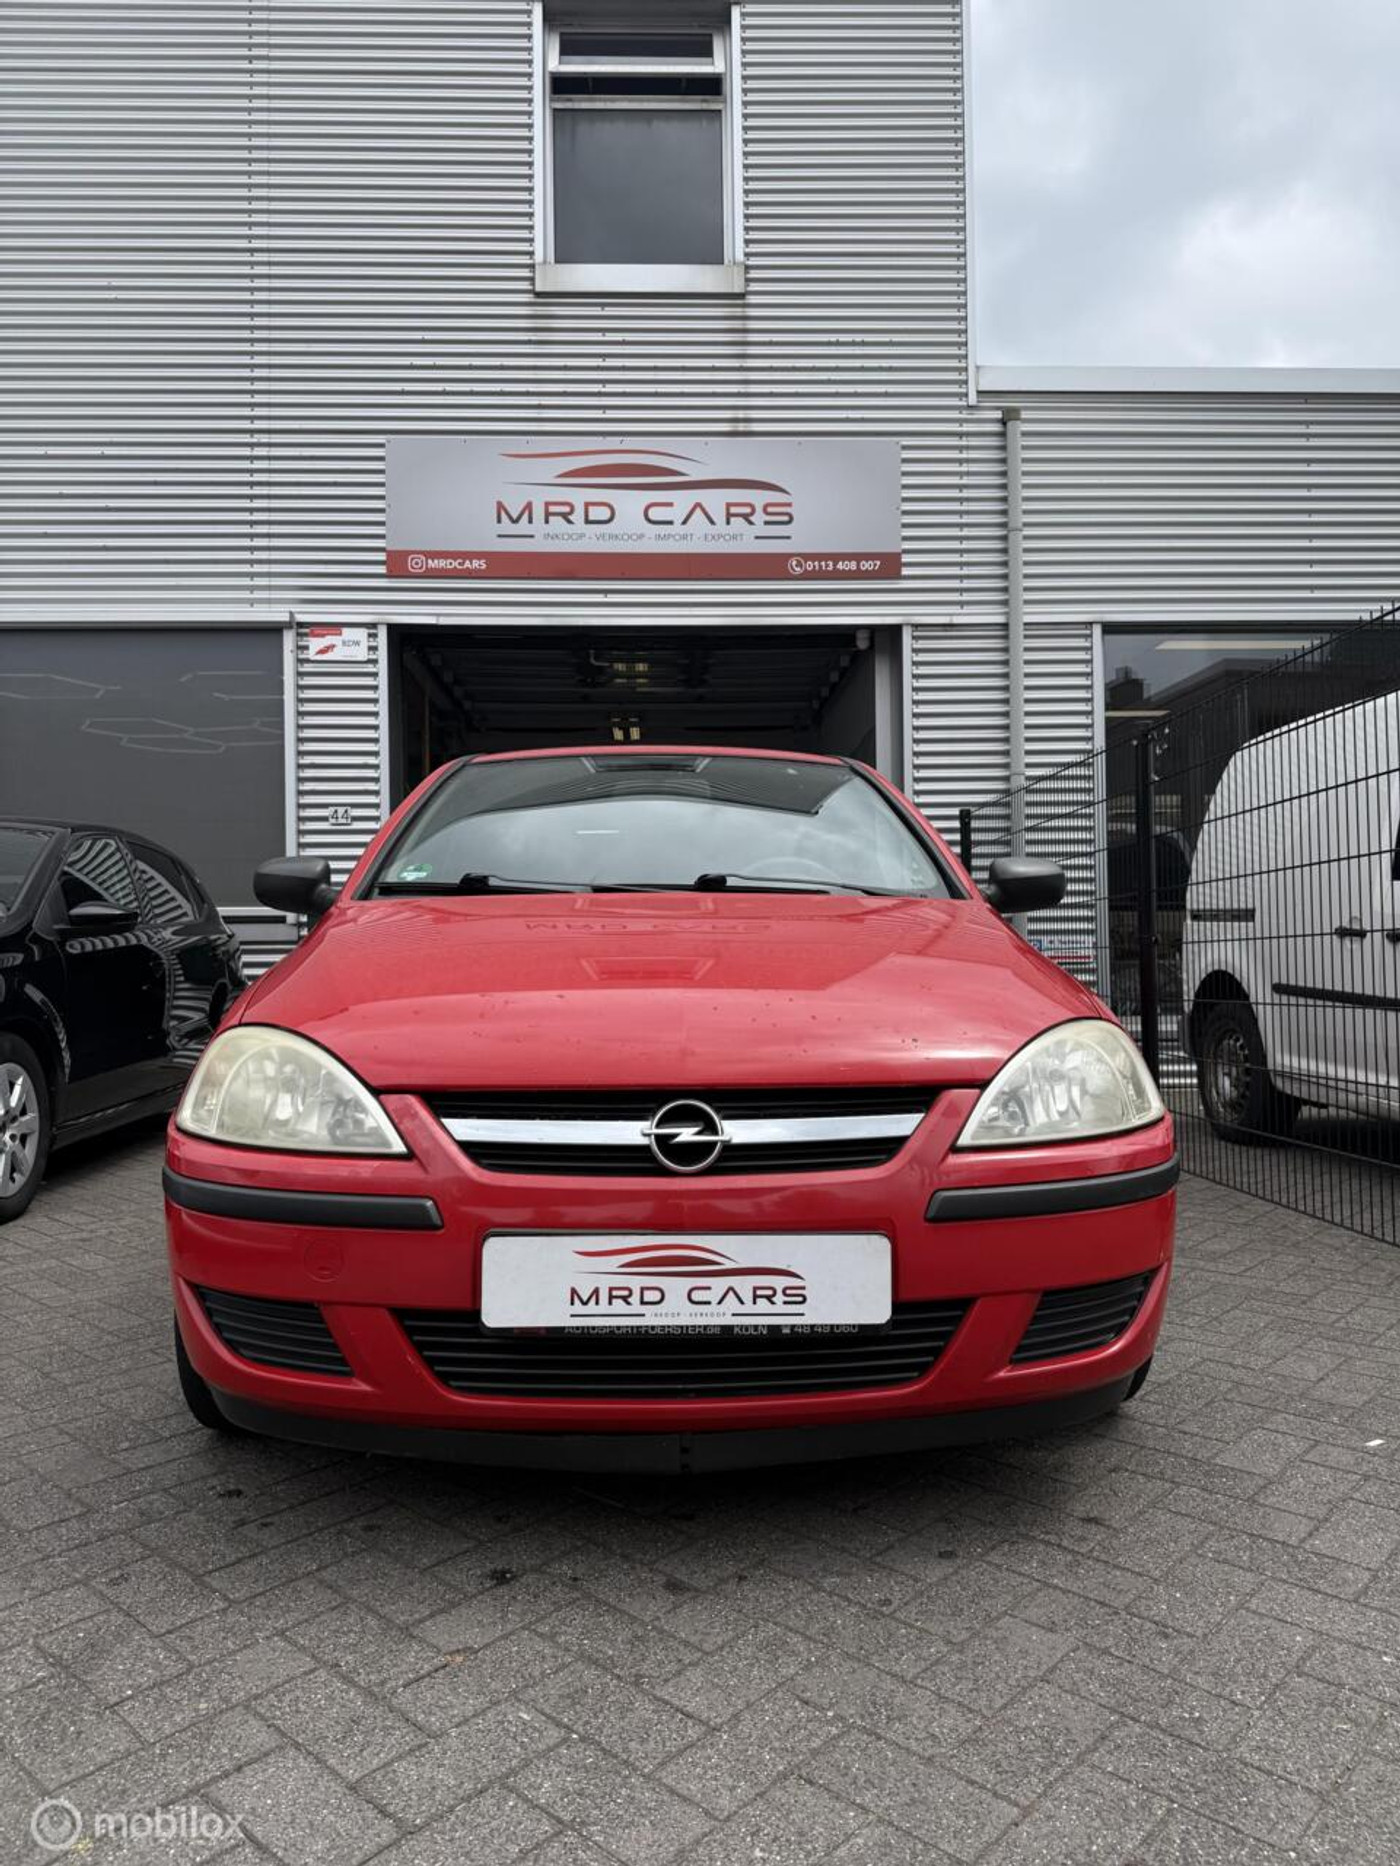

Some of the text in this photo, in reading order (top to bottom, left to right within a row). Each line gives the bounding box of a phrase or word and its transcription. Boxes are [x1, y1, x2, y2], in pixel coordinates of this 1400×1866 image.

[496, 501, 794, 526] MRD CARS
[543, 532, 744, 542] INKOOP VERKOOP IMPORT EXPORT
[427, 558, 487, 570] MRDCARS
[806, 561, 880, 571] 0113 408 007
[331, 808, 349, 822] 44
[570, 1286, 807, 1306] MRD CARS
